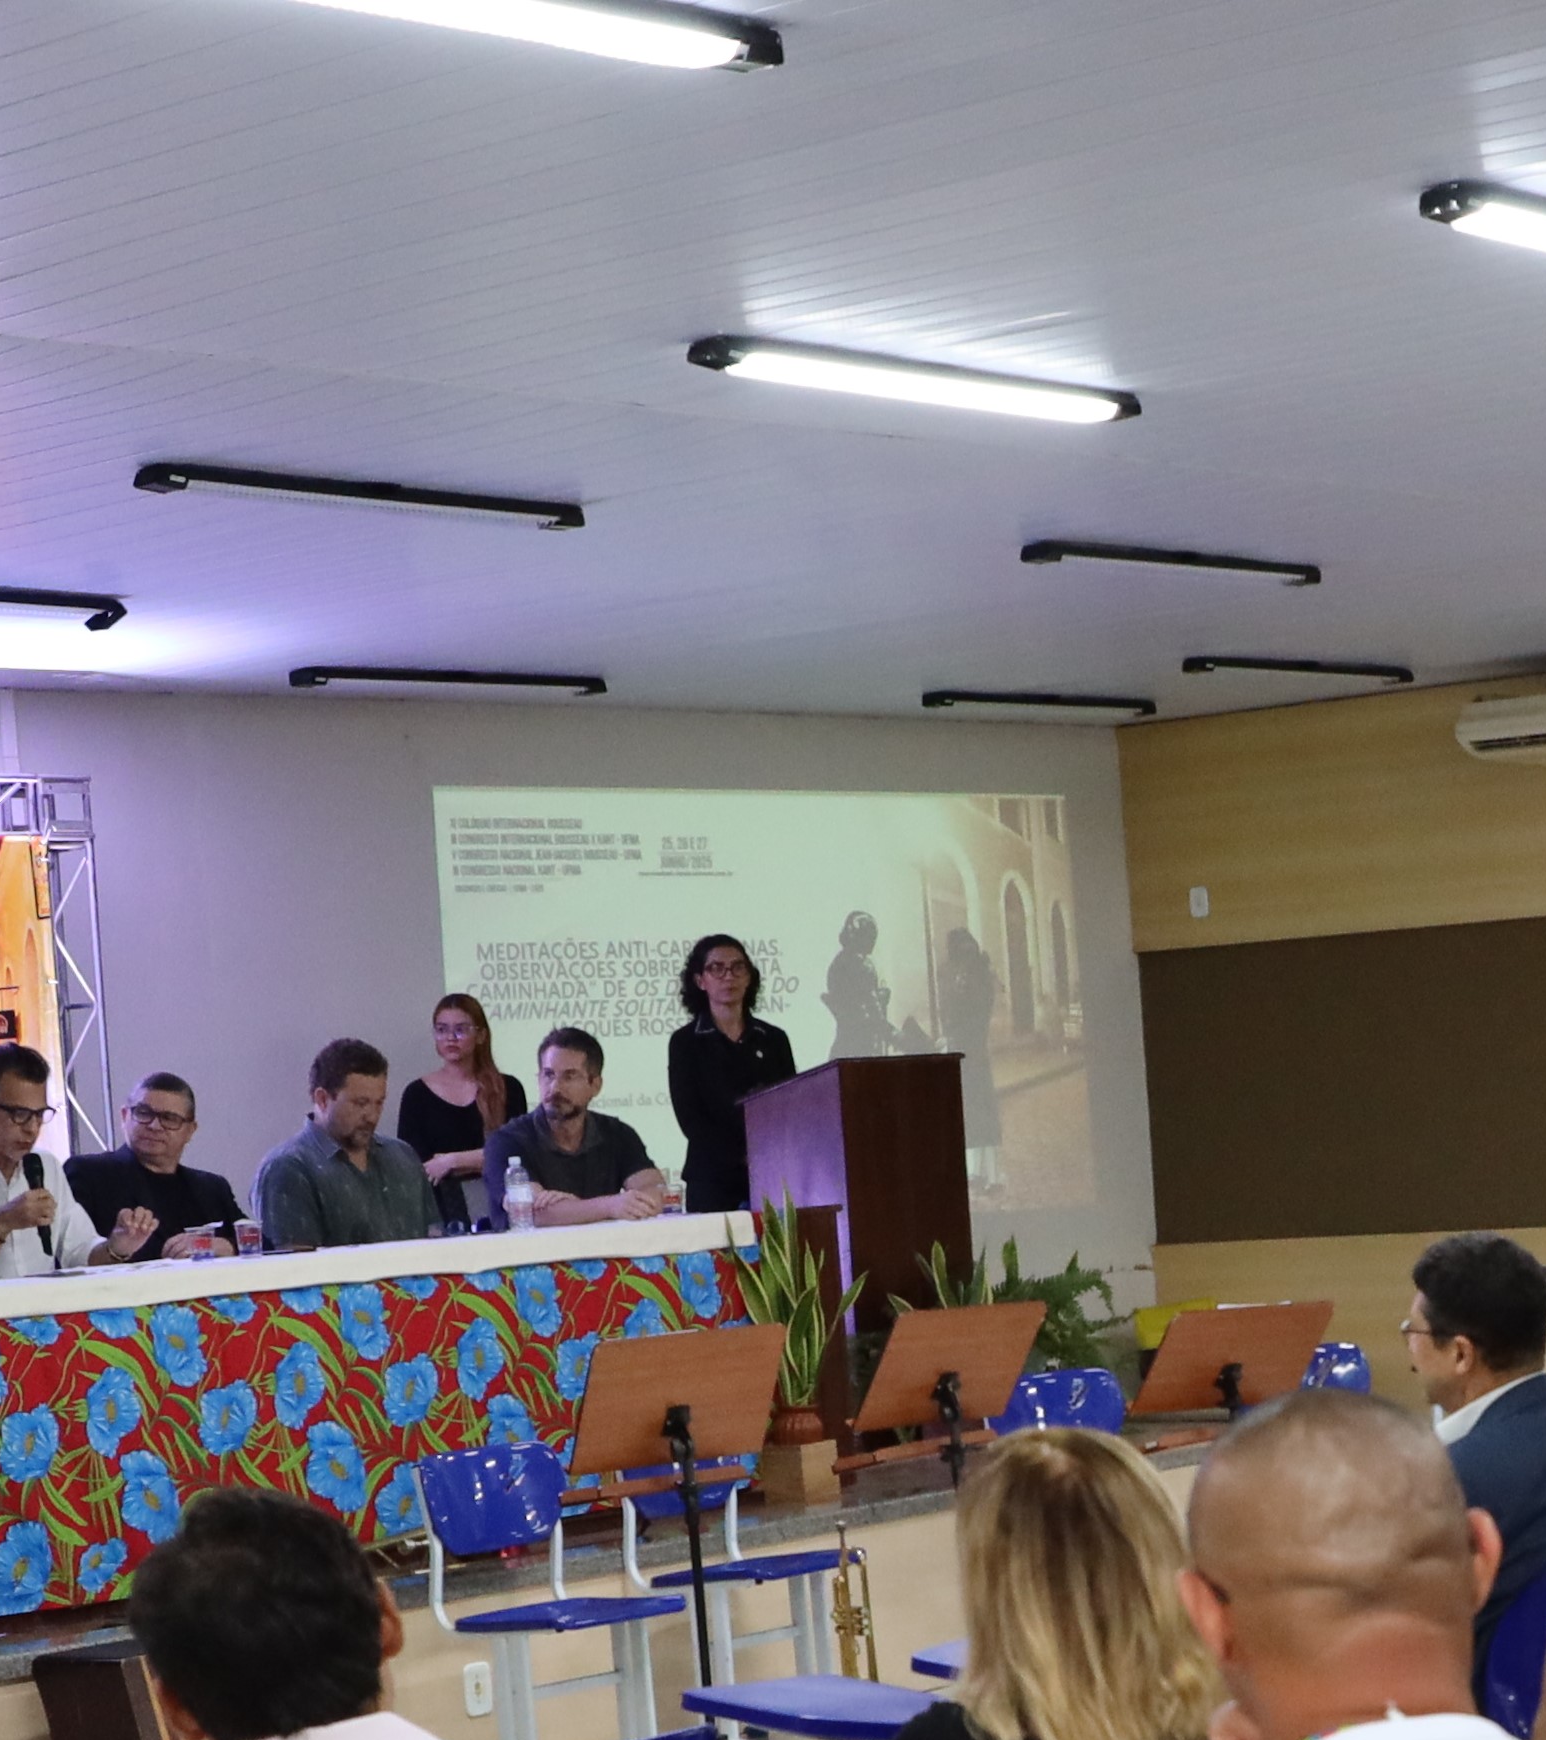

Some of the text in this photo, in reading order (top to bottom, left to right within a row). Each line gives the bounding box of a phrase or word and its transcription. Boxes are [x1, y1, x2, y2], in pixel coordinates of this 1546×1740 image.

[476, 938, 599, 963] MEDITAÇÕES
[480, 957, 680, 981] OBSERVAÇÕES SOBRE
[604, 979, 627, 998] DE
[634, 979, 659, 998] OS
[771, 976, 800, 994] DO
